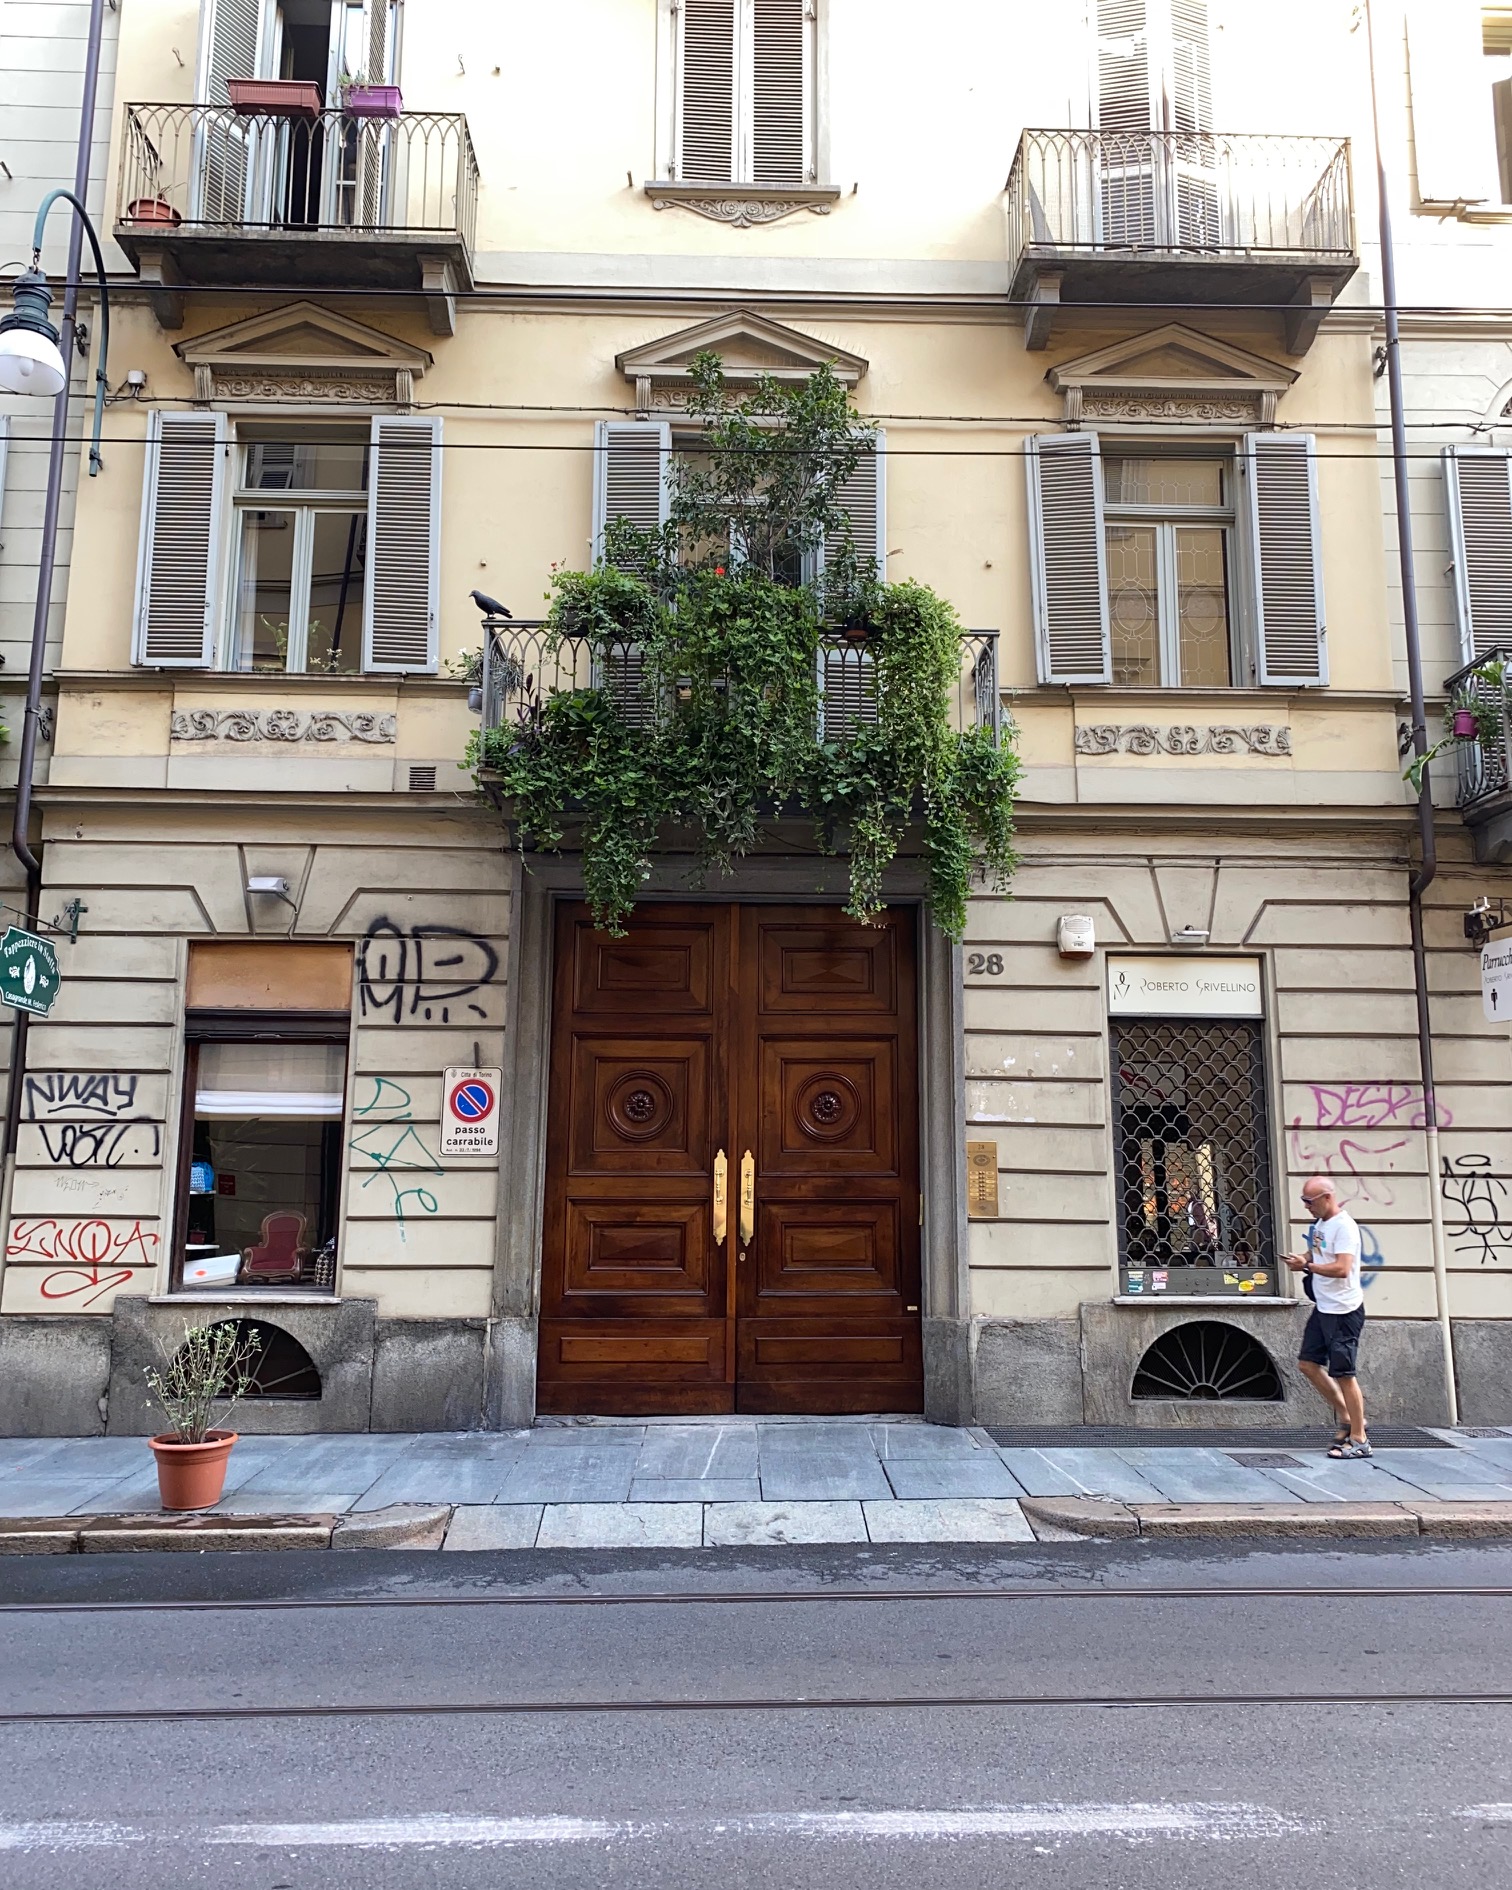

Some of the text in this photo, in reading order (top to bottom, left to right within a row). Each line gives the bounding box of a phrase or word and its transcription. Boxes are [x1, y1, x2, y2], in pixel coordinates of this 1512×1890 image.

[4, 937, 37, 958] Tappezziere
[42, 947, 55, 974] Stoffa
[968, 953, 1004, 975] 28
[455, 1127, 485, 1135] passo
[446, 1137, 493, 1146] carrabile
